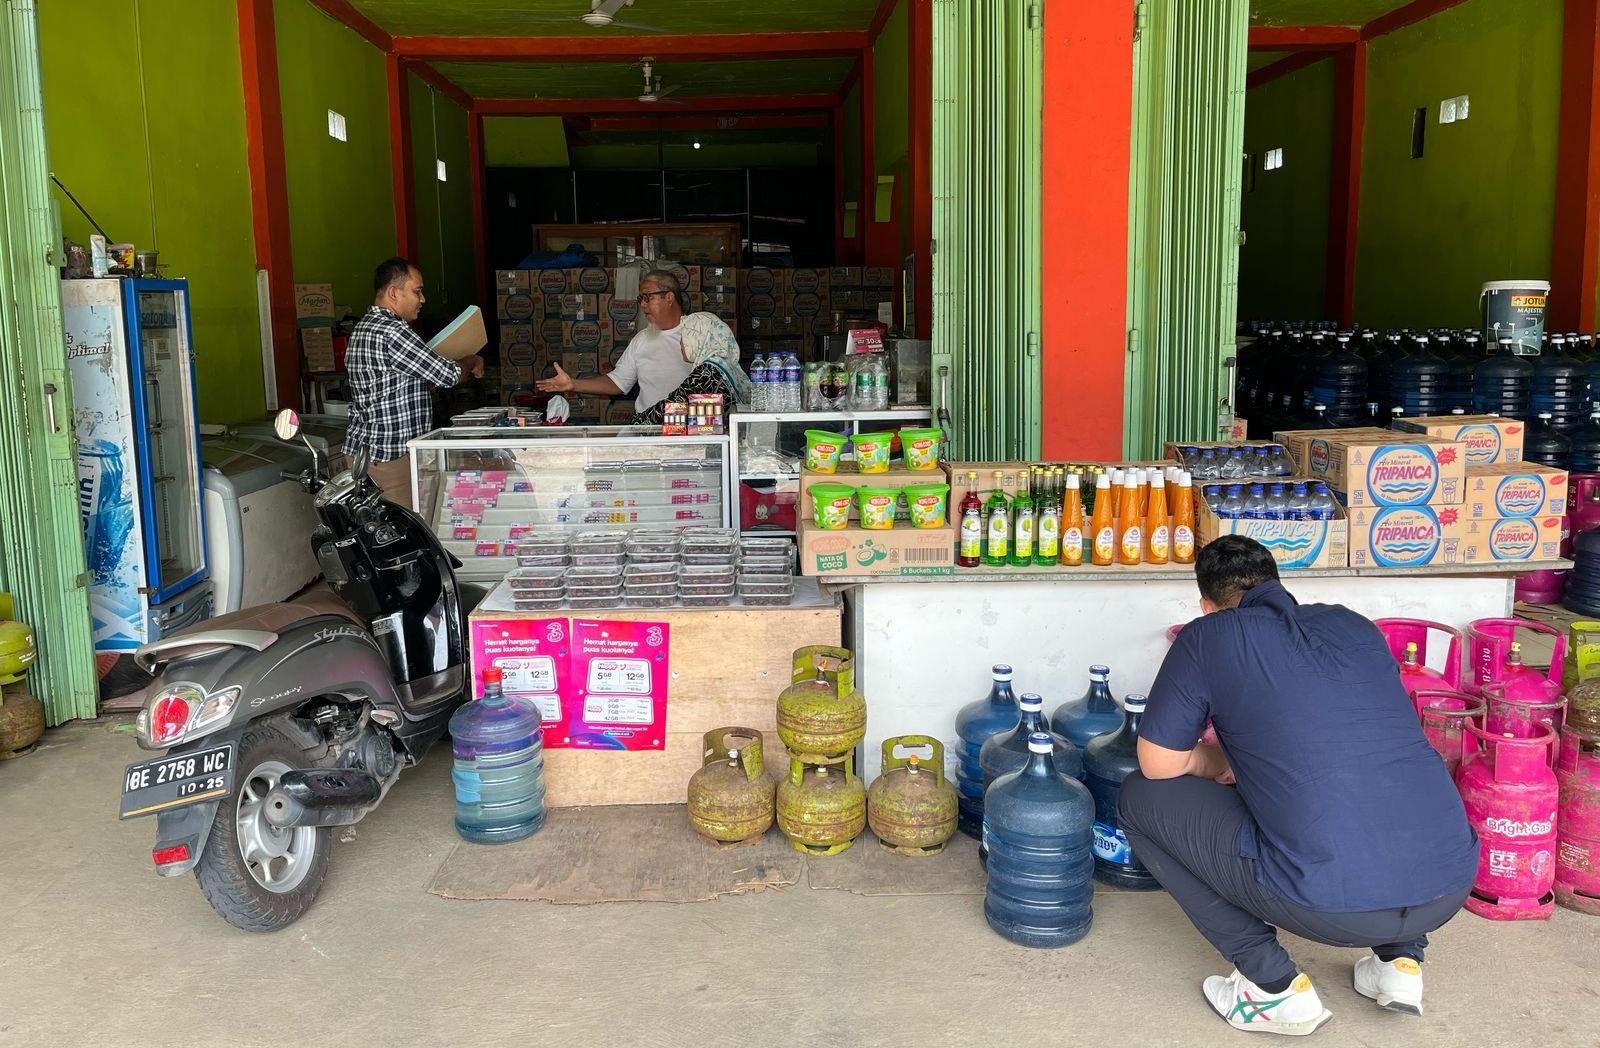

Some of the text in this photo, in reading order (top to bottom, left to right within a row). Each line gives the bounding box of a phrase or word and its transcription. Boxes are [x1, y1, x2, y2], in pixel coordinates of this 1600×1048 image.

[1372, 465, 1432, 485] TRIPANCA
[1500, 490, 1541, 502] TRIPANCA
[1245, 520, 1317, 538] TRIPANCA
[1375, 526, 1434, 545] TRIPANCA
[1494, 532, 1534, 545] TRIPANCA
[822, 561, 843, 569] COCO
[942, 567, 951, 575] kg
[314, 626, 367, 642] Stylish
[607, 639, 639, 647] harganya
[503, 645, 536, 653] kuotanya!
[601, 647, 634, 655] kuotanya!
[502, 672, 508, 680] 5
[531, 671, 540, 679] 12
[597, 672, 603, 680] 5
[130, 752, 225, 790] BE 2758 WC
[1488, 818, 1551, 837] Bright Gas
